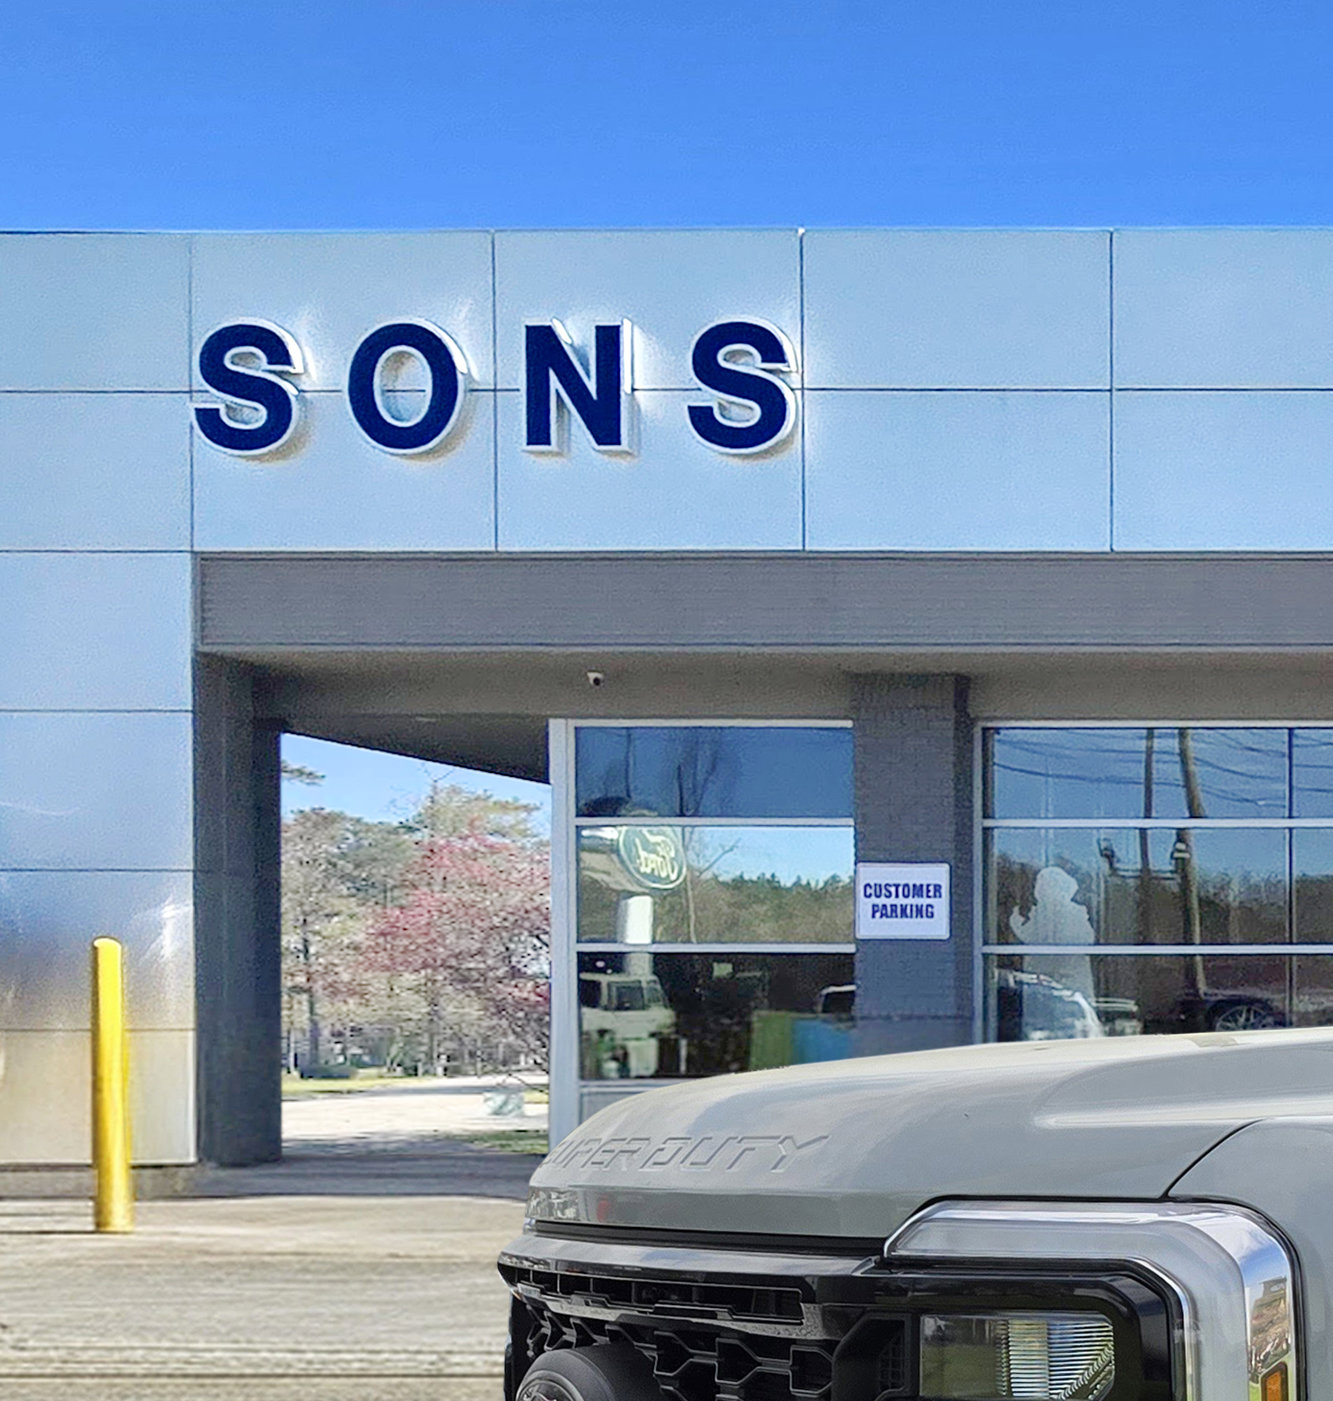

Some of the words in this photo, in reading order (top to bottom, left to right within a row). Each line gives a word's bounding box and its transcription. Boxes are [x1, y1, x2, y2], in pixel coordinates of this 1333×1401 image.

[193, 319, 799, 455] SONS
[863, 883, 942, 899] CUSTOMER
[871, 903, 935, 919] PARKING
[640, 1135, 831, 1174] DUTY
